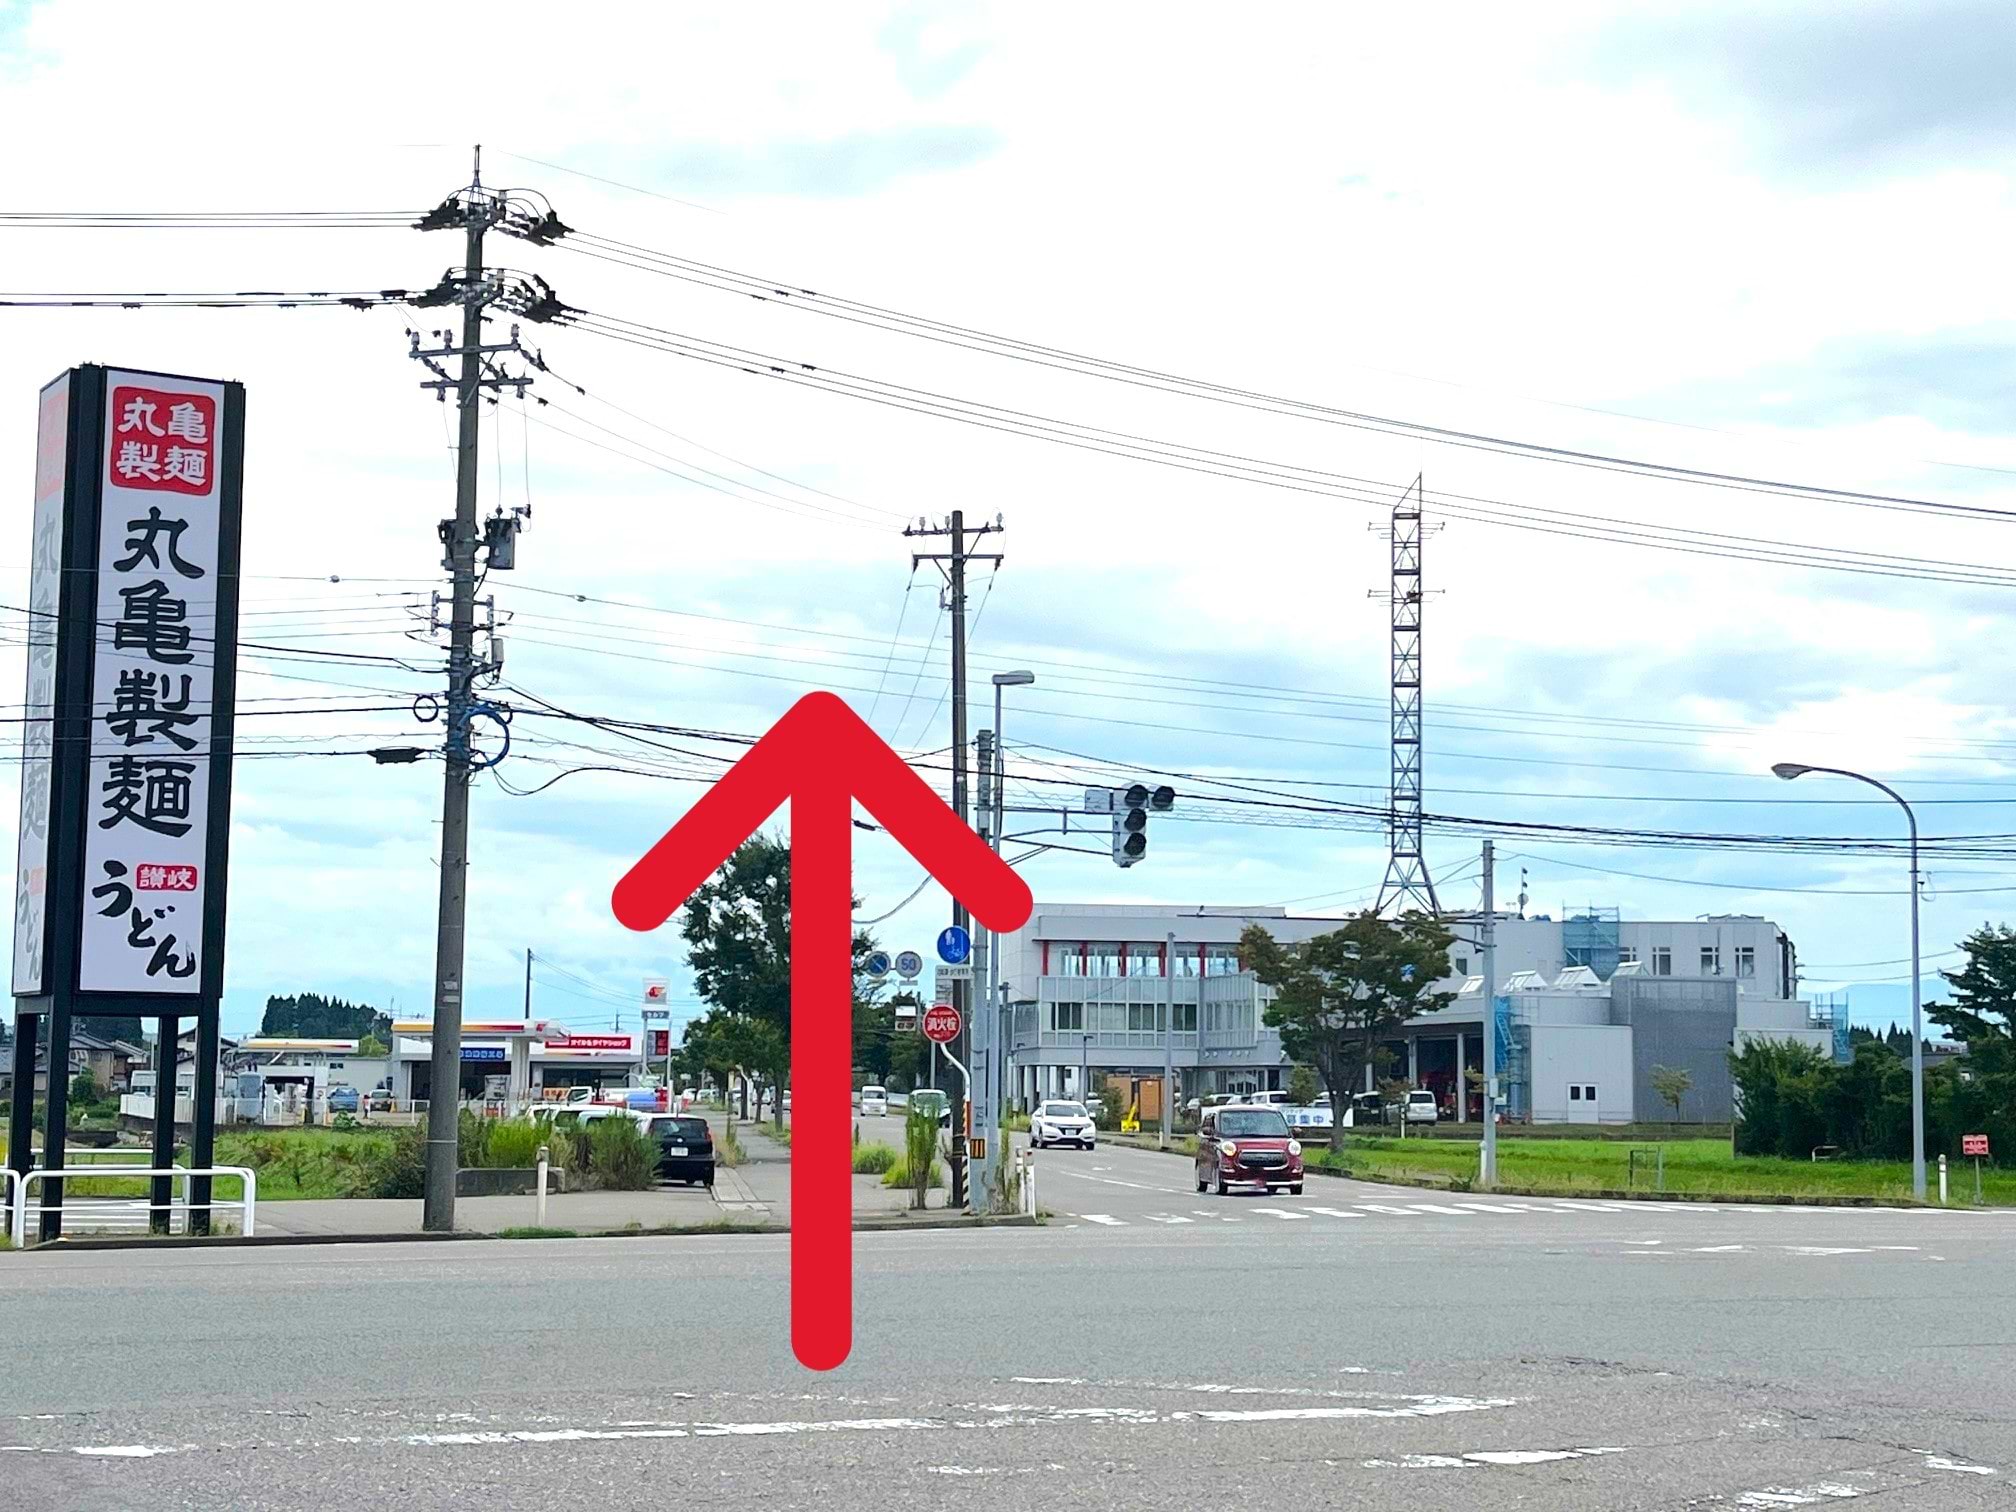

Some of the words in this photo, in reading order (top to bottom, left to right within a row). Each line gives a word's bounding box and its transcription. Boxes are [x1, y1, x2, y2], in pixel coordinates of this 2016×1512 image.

[117, 397, 208, 444] 丸亀
[115, 440, 208, 487] 製麺
[98, 506, 205, 838] 丸亀製麺
[139, 866, 195, 890] 讃岐
[91, 859, 196, 978] うどん
[901, 959, 916, 971] 50
